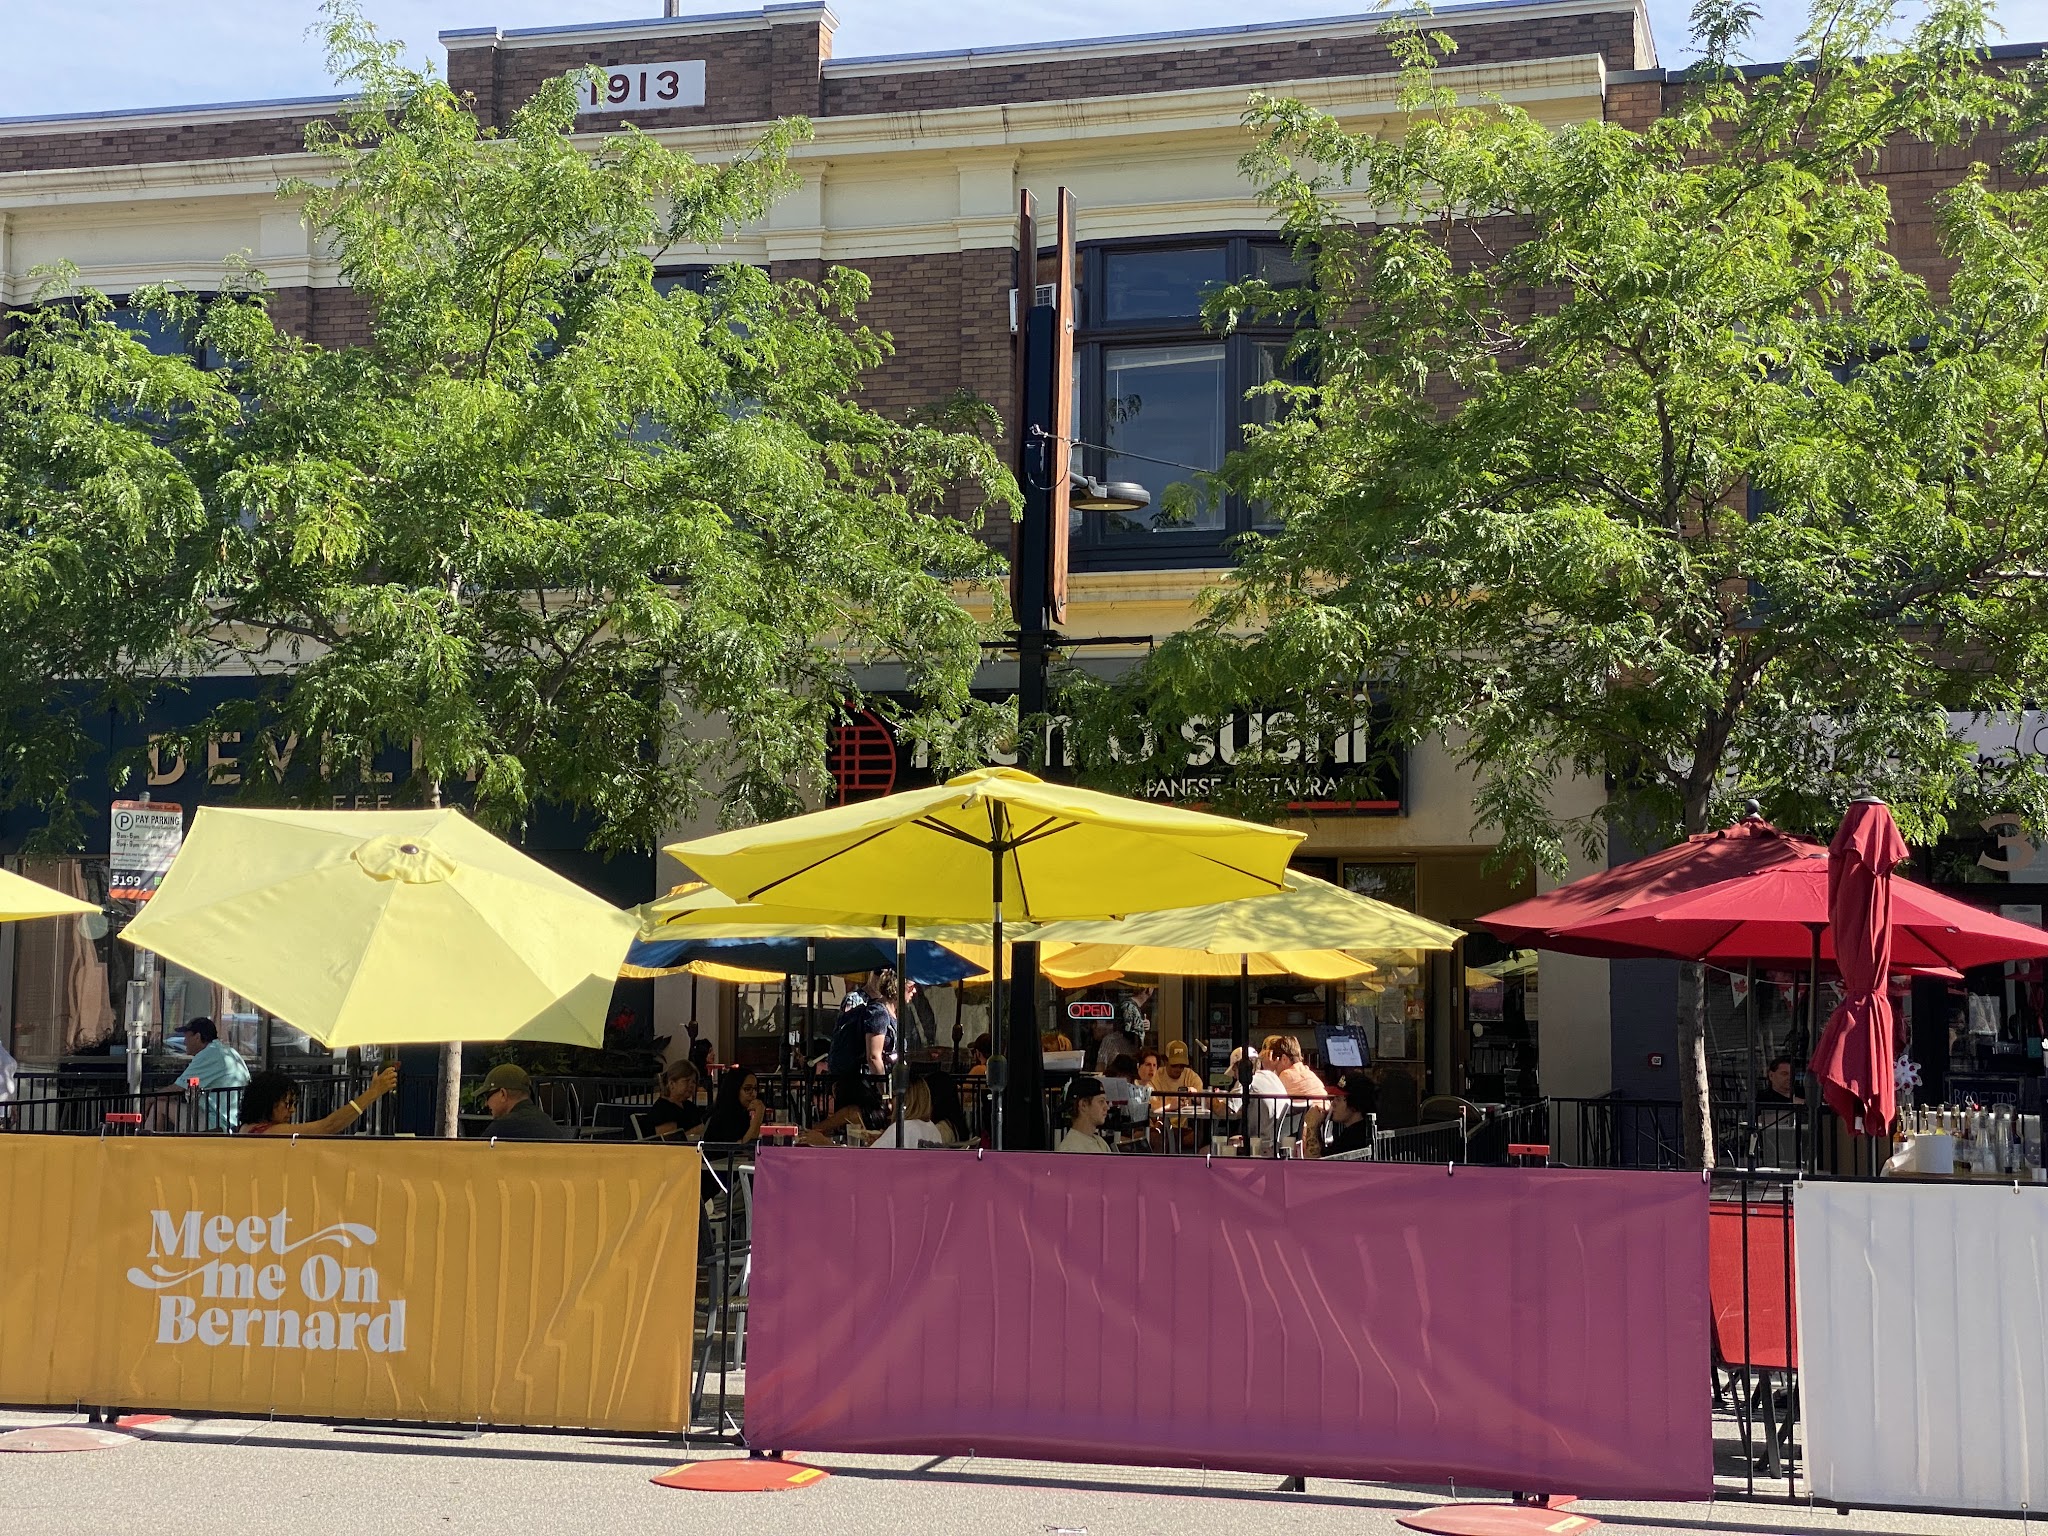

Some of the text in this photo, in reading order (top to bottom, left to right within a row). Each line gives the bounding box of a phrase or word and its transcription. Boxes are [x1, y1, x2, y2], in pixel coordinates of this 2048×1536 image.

[590, 70, 679, 106] 1913
[1180, 694, 1367, 767] sushi
[120, 815, 130, 828] P
[135, 814, 180, 826] PAY PARKING
[1977, 812, 2034, 872] 3
[111, 875, 141, 887] 3199
[1070, 1004, 1112, 1017] OPEN
[146, 1207, 378, 1259] Meet
[126, 1253, 380, 1304] me On
[155, 1295, 407, 1354] Bernard
